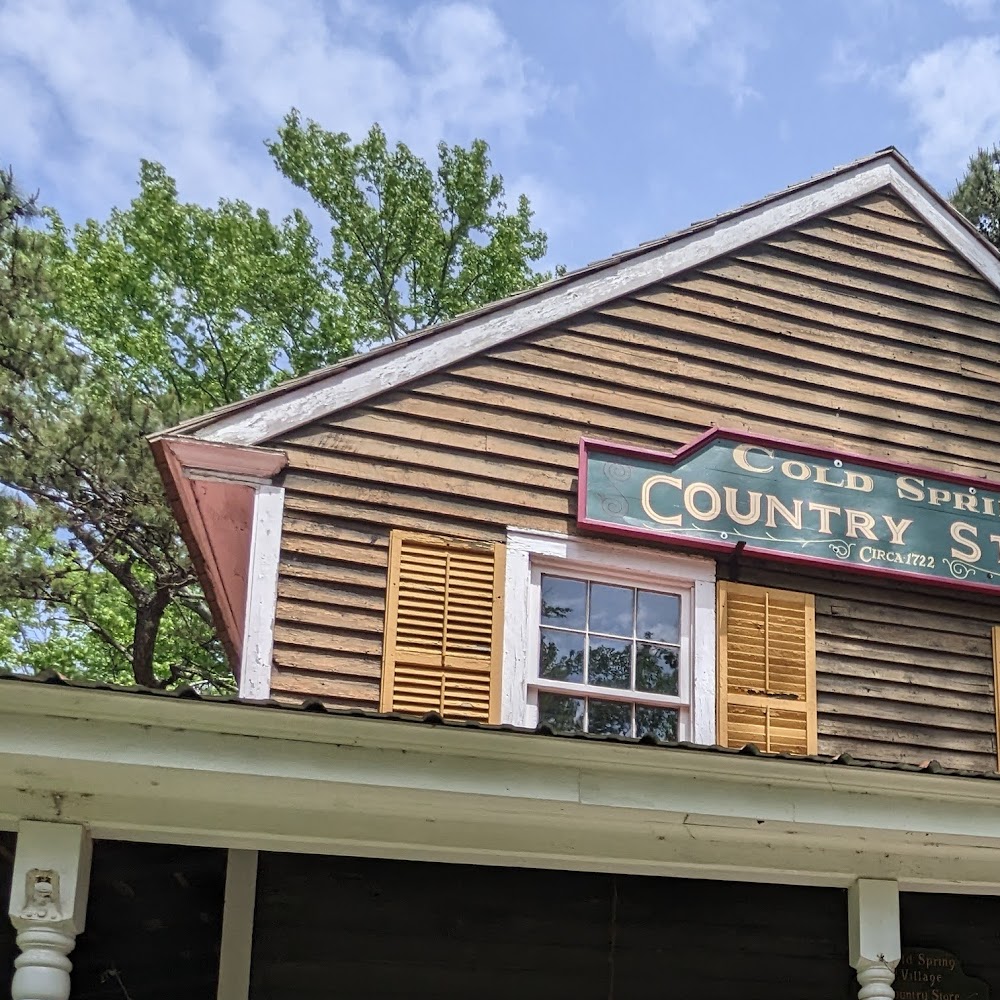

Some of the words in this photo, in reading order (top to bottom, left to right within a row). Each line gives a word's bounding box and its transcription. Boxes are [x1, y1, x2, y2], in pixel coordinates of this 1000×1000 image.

[732, 443, 874, 493] COLD
[641, 474, 914, 546] COUNTRY
[901, 968, 942, 987] Village
[918, 953, 956, 971] Spring
